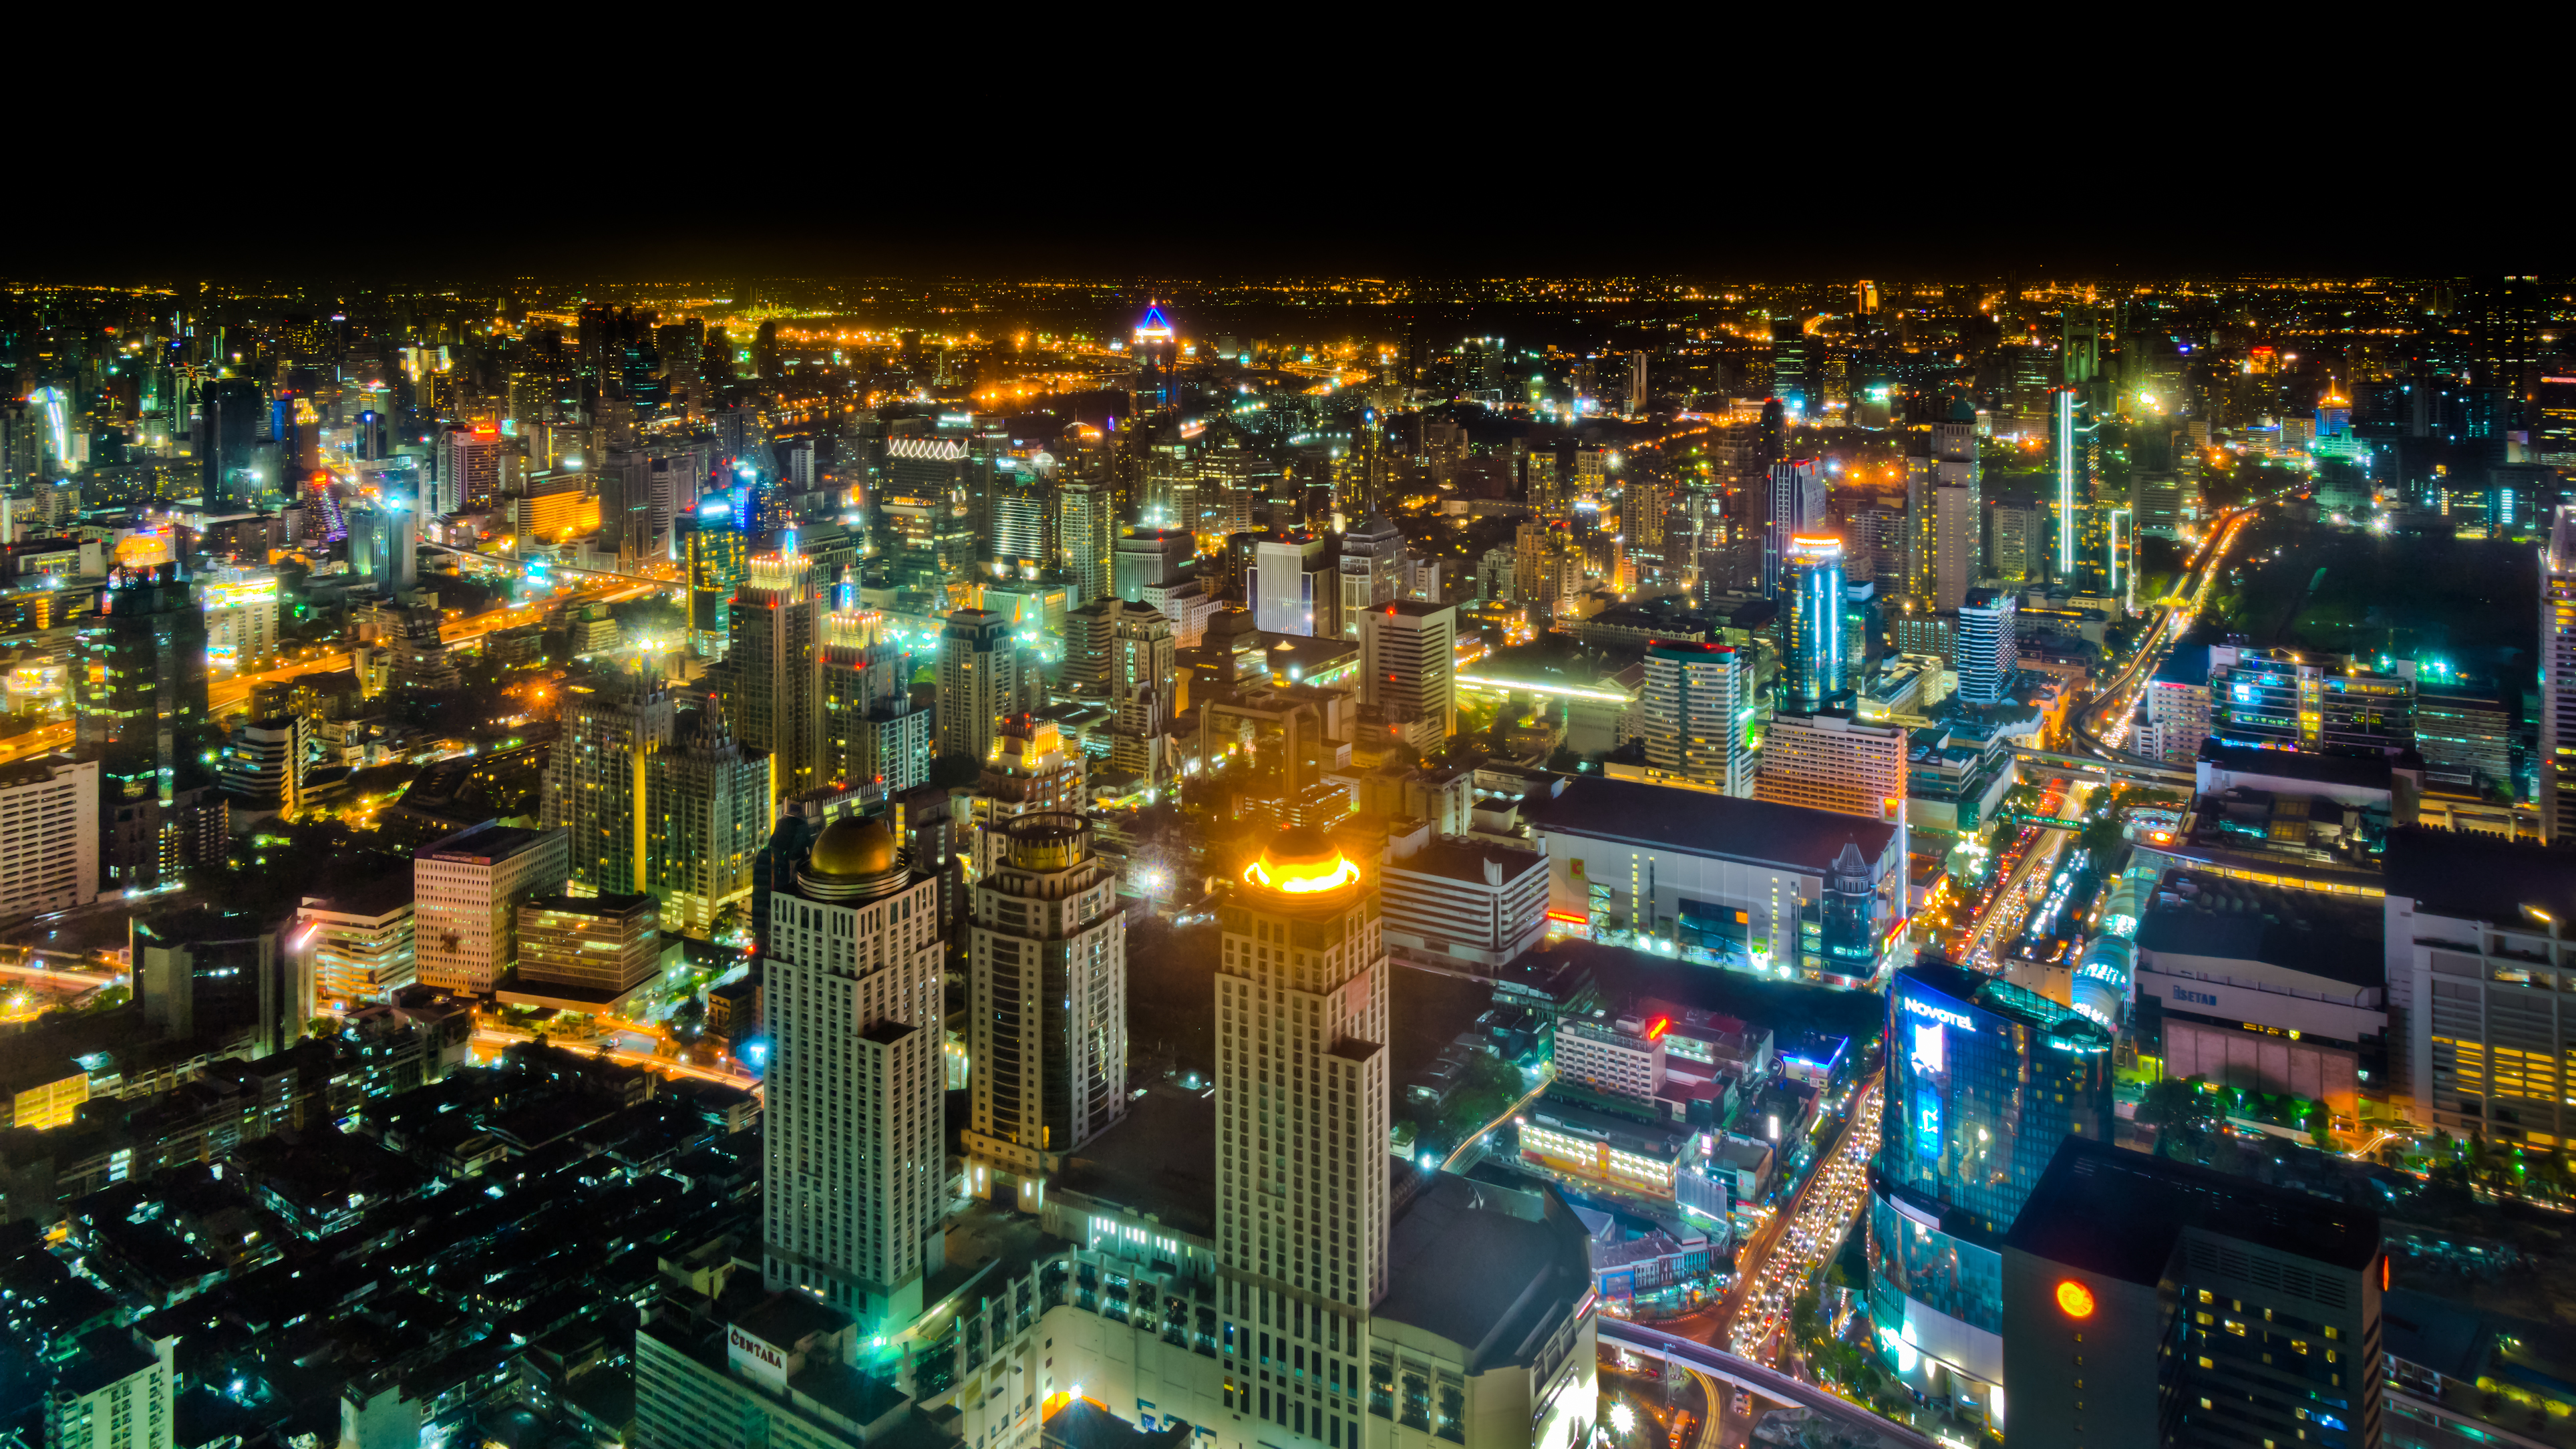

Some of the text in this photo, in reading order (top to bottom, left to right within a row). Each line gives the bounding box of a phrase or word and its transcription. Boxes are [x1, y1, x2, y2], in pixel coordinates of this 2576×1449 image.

[2173, 985, 2217, 1006] ISETAN
[1905, 996, 1977, 1032] NOVOTEL
[730, 1328, 782, 1370] CENTARA
